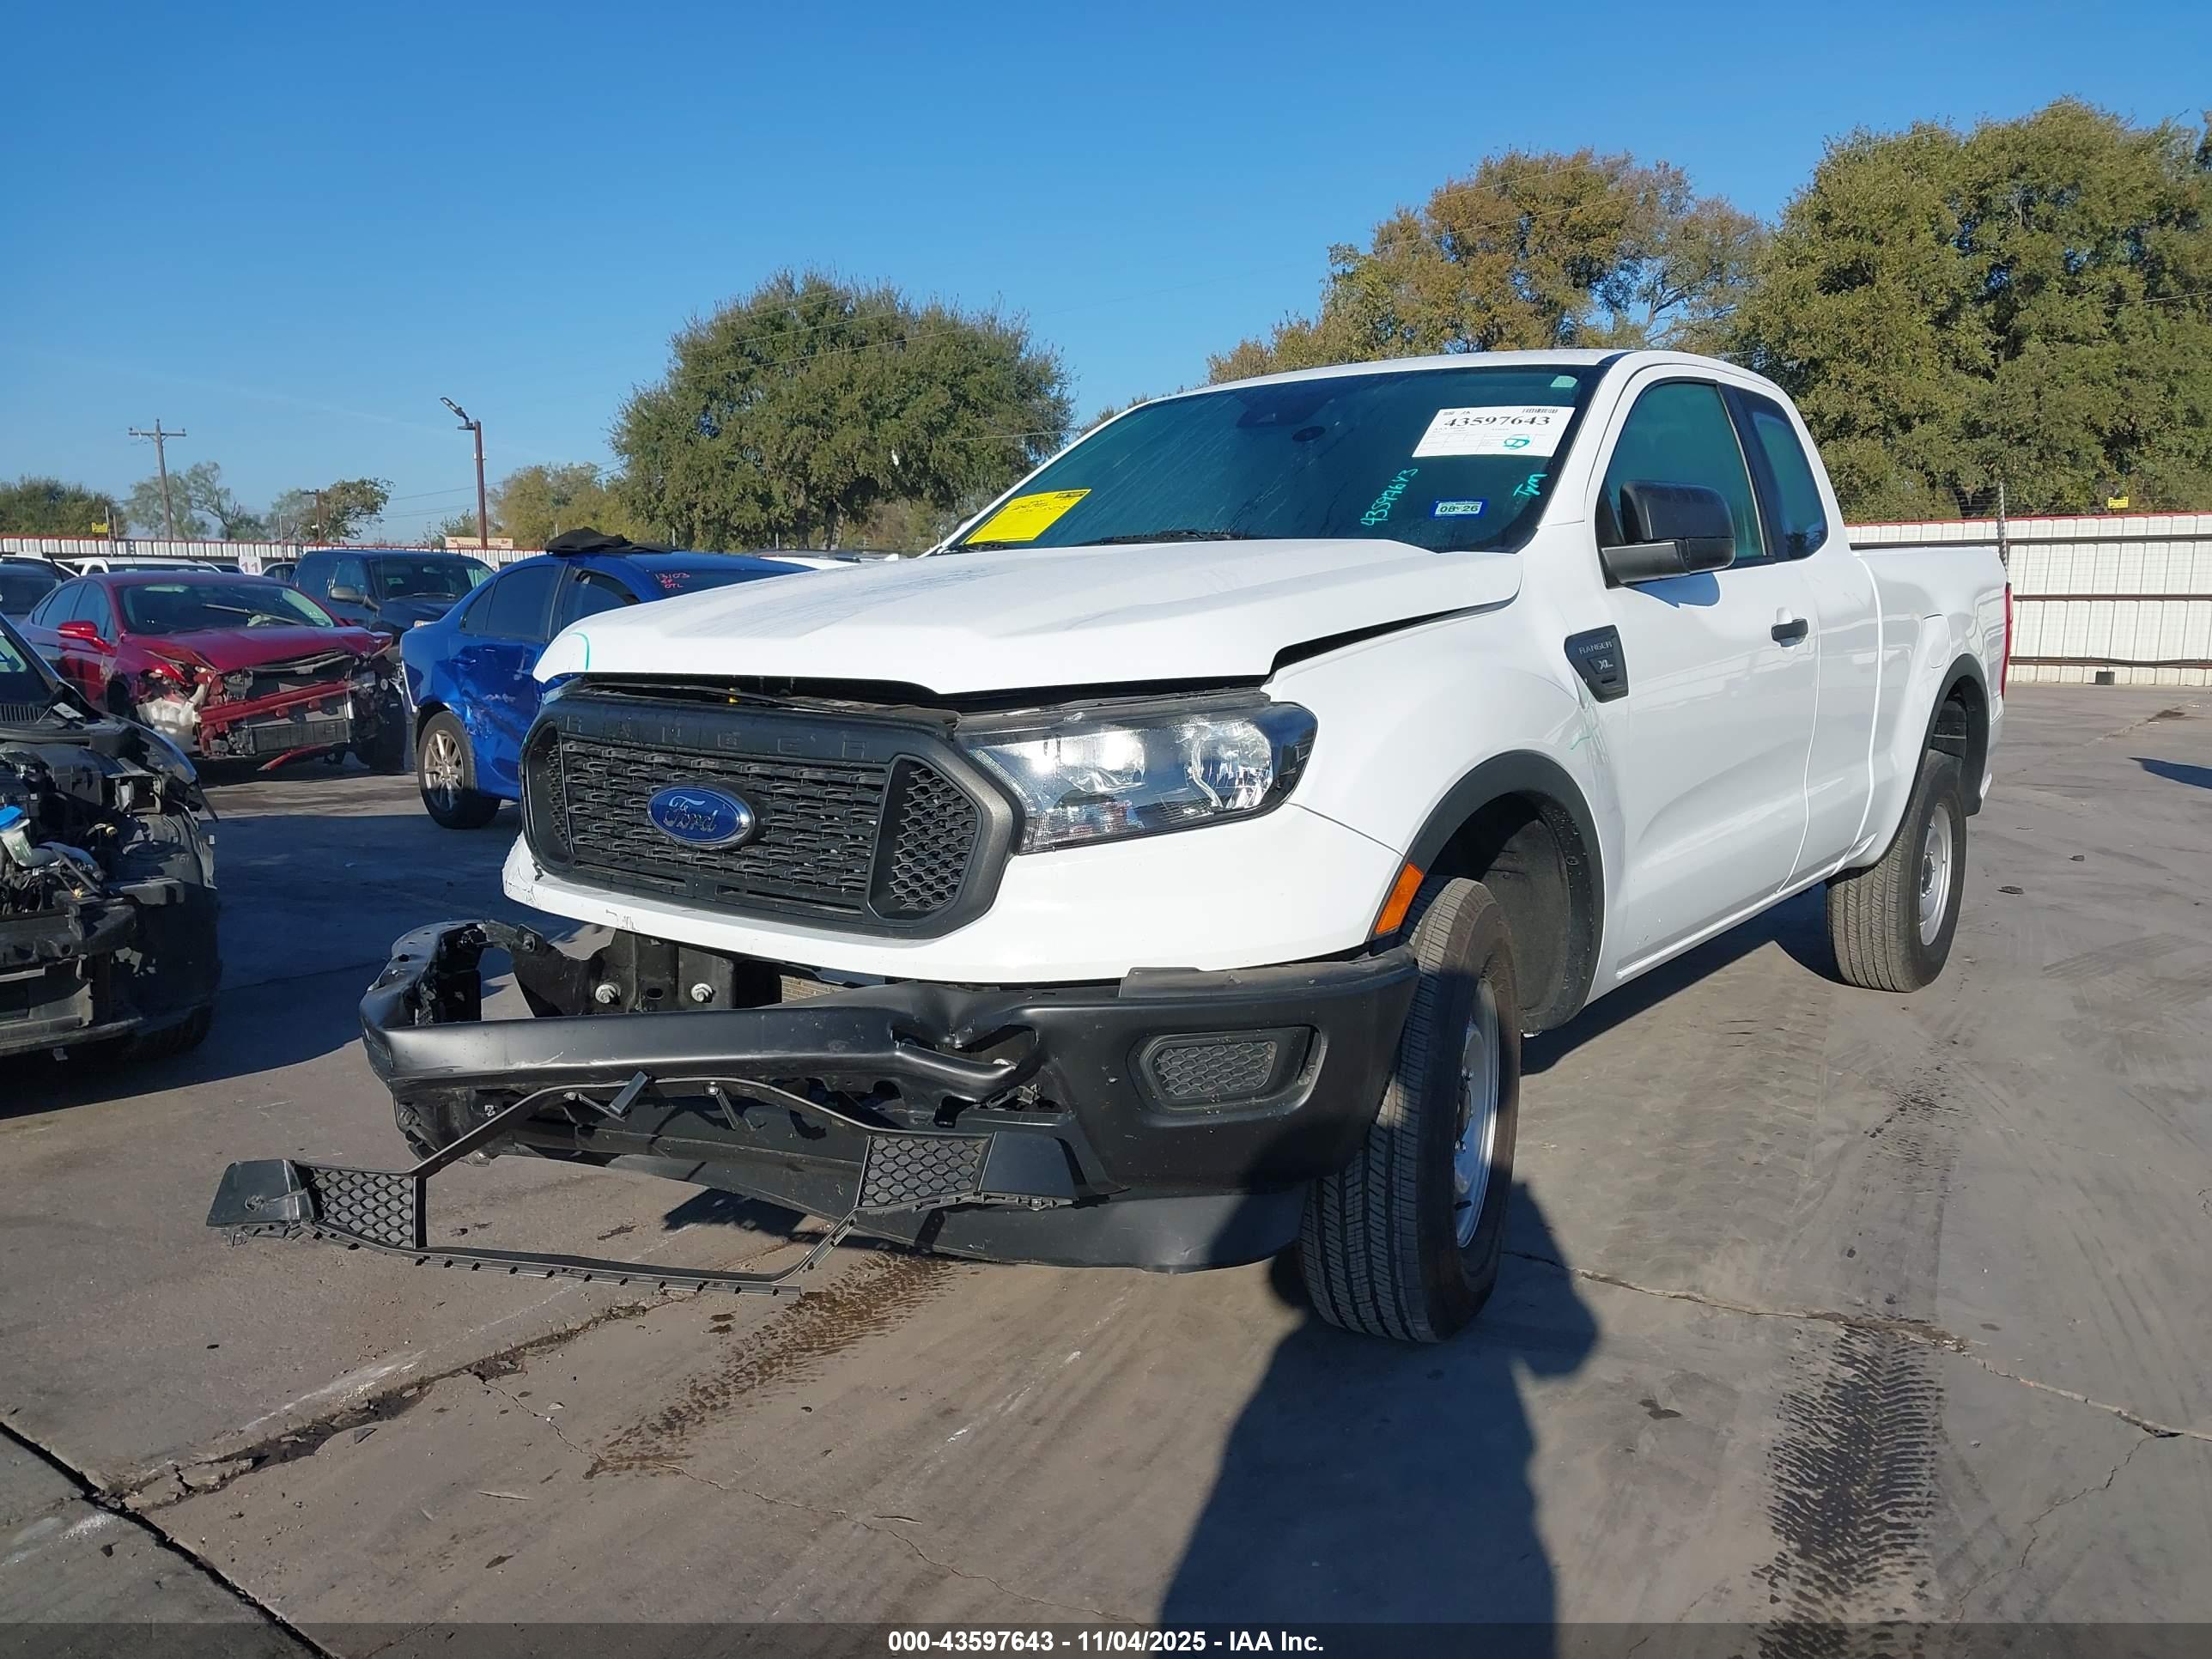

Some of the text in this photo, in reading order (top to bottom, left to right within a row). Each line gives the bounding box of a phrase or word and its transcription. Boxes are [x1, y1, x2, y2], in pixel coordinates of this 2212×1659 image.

[1443, 415, 1552, 428] 43597643
[241, 562, 258, 574] 11
[1578, 641, 1613, 655] RANGER
[1597, 659, 1614, 671] XL
[566, 714, 867, 759] RANGER
[662, 795, 718, 833] Ford
